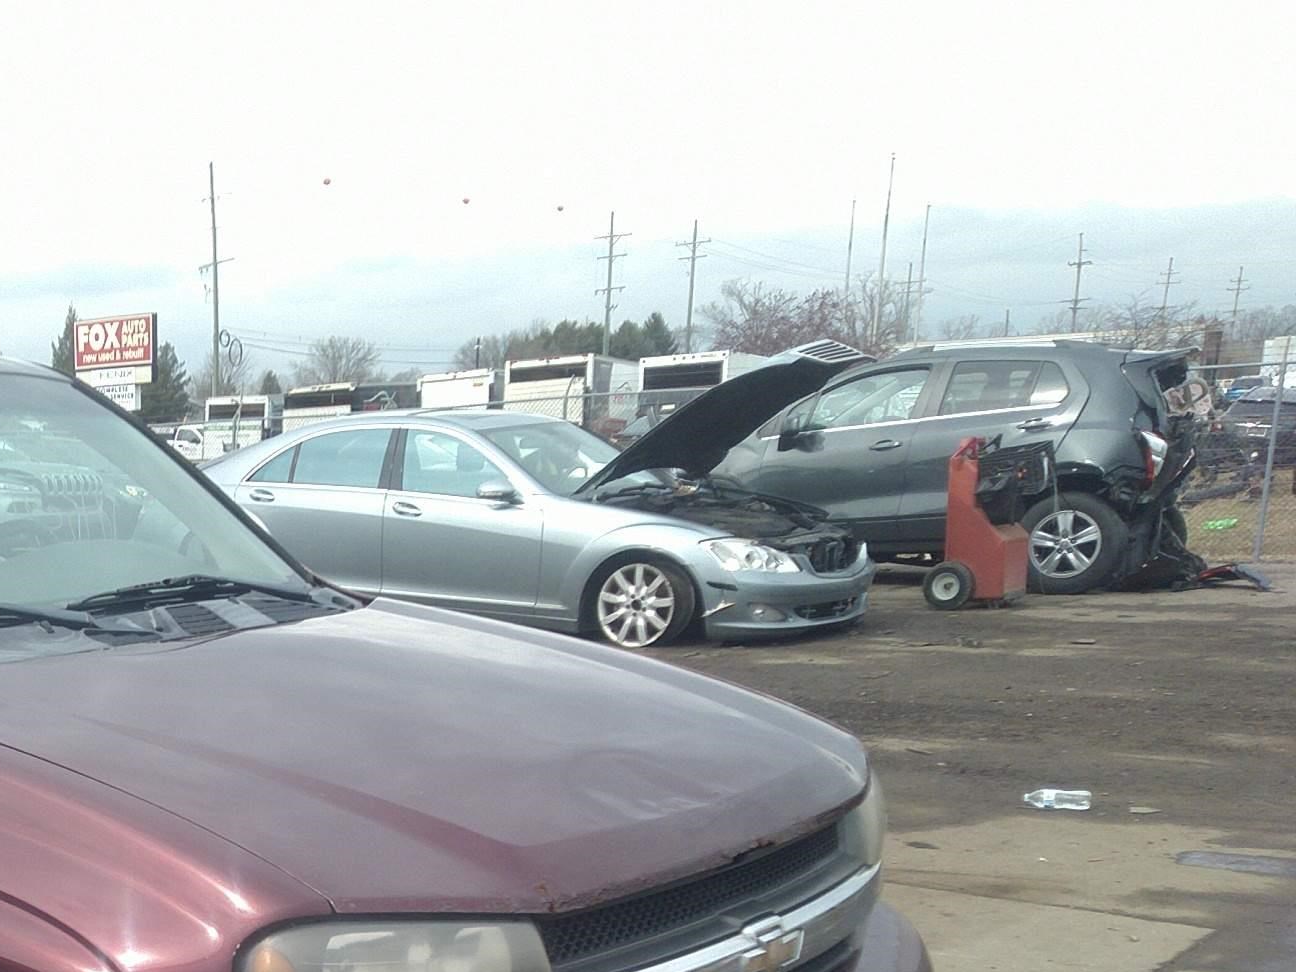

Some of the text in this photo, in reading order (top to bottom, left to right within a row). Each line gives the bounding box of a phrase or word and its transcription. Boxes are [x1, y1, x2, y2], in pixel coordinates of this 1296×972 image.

[121, 319, 147, 334] AUTO
[77, 321, 121, 353] FOX
[121, 332, 149, 348] PARTS
[82, 353, 97, 364] new
[98, 350, 115, 361] used
[122, 348, 145, 360] rebuilt
